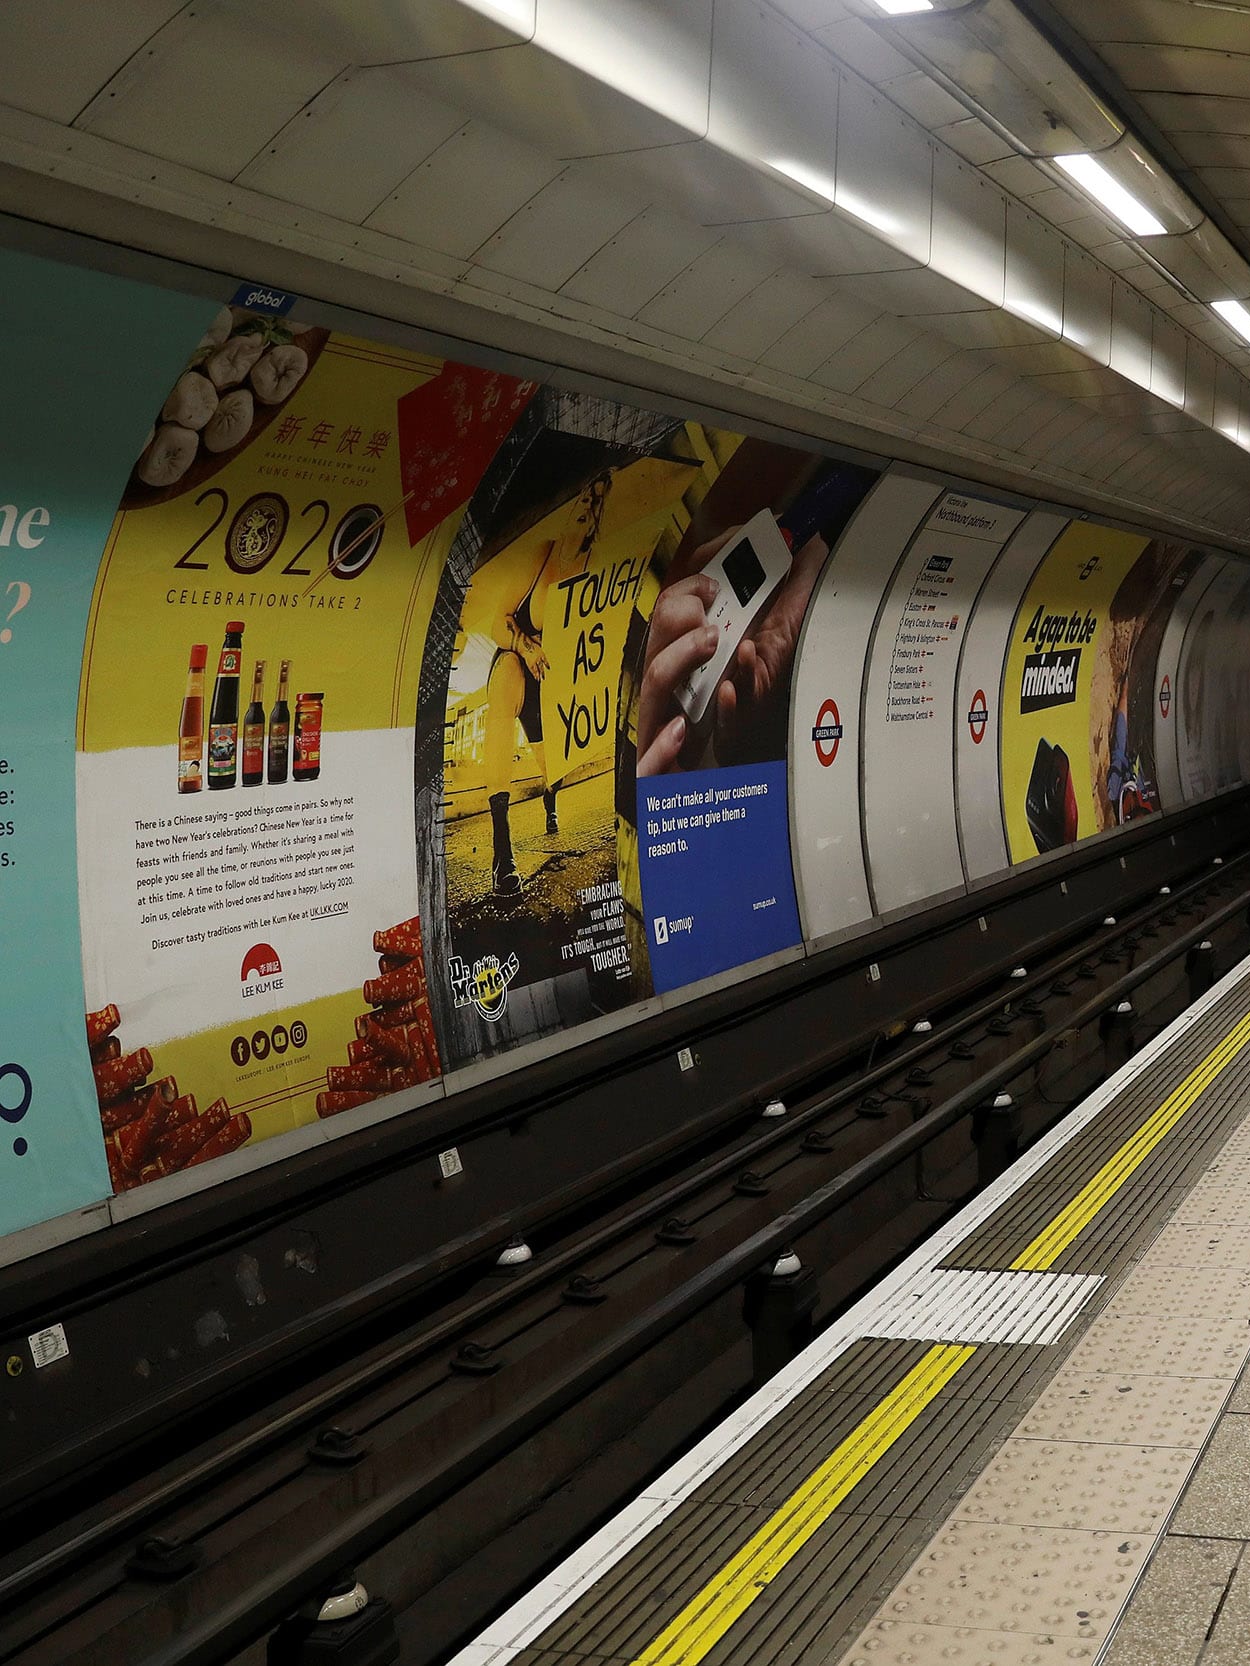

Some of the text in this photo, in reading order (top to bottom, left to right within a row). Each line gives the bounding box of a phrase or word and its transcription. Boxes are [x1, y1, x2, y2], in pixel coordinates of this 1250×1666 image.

[245, 290, 286, 309] global
[273, 414, 391, 458] 新年快樂
[258, 466, 289, 477] KUNG
[295, 471, 313, 480] HEI
[174, 488, 385, 580] 2020
[166, 589, 361, 610] CELEBRATIONS TAKE 2
[558, 556, 647, 629] TOUGH
[1023, 605, 1097, 653] A gap to be
[573, 622, 604, 685] AS
[1022, 654, 1076, 697] minded.
[558, 687, 609, 761] YOU
[815, 728, 840, 738] GREEN PARK
[135, 820, 156, 830] There
[174, 816, 202, 826] Chinese
[205, 812, 228, 824] saying
[235, 808, 252, 820] good
[254, 806, 274, 816] things
[301, 801, 318, 812] pairs.
[320, 799, 328, 808] So
[330, 797, 342, 807] why
[647, 783, 768, 812] We can't make all your customers
[136, 812, 354, 849] have two New Year's celebrations? Chinese New Year time for
[647, 808, 746, 837] tip, but we can give them a
[136, 828, 354, 868] feasts with friends and family. Whether it's sharing meal with
[648, 838, 689, 858] reason to.
[137, 845, 354, 890] people you see all the time, reunions with people you see just
[138, 862, 355, 906] at this time. time follow old traditions and start new ones.
[141, 913, 157, 924] Join
[159, 912, 170, 921] us,
[172, 906, 206, 918] celebrate
[208, 900, 224, 910] with
[225, 895, 244, 908] loved
[246, 897, 261, 905] ones
[263, 891, 274, 901] and
[276, 889, 291, 898] have
[320, 880, 336, 891] lucky
[337, 876, 354, 887] 2020.
[602, 898, 624, 918] FLAWS
[152, 901, 348, 950] Discover tasty traditions with Lee Kum Kee at UK.LKK.COM
[605, 916, 626, 931] WORLD.
[669, 917, 692, 934] sumup
[561, 944, 574, 960] IT'S
[573, 938, 596, 956] TOUGH.
[242, 978, 284, 998] LEE KUM KEE
[451, 951, 520, 1008] Martens
